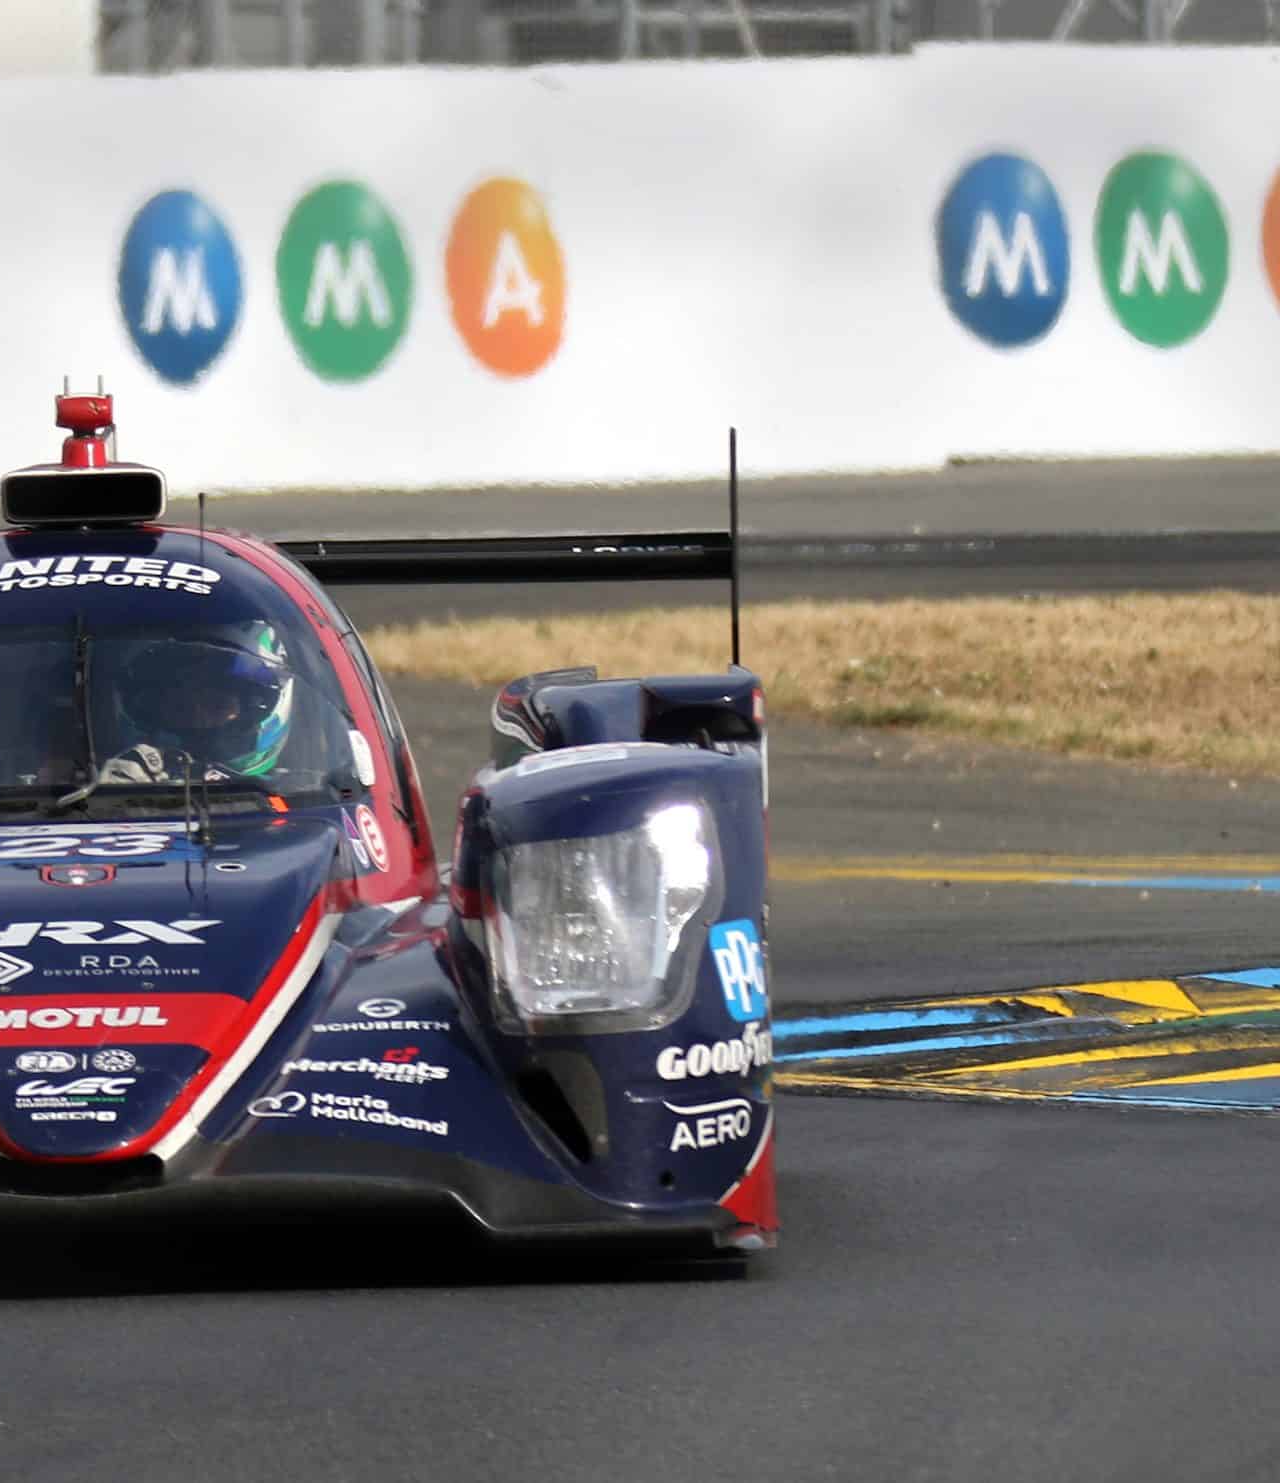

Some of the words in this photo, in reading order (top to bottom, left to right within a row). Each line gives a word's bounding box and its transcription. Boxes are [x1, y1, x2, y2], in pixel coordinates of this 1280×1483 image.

[80, 954, 160, 968] RDA
[42, 968, 114, 977] DEVELOP
[312, 1020, 450, 1033] SCHUBERTH
[281, 1058, 450, 1080] Merchants
[311, 1092, 389, 1110] Maria
[311, 1105, 449, 1137] Mallaband
[669, 1109, 751, 1153] AERO
